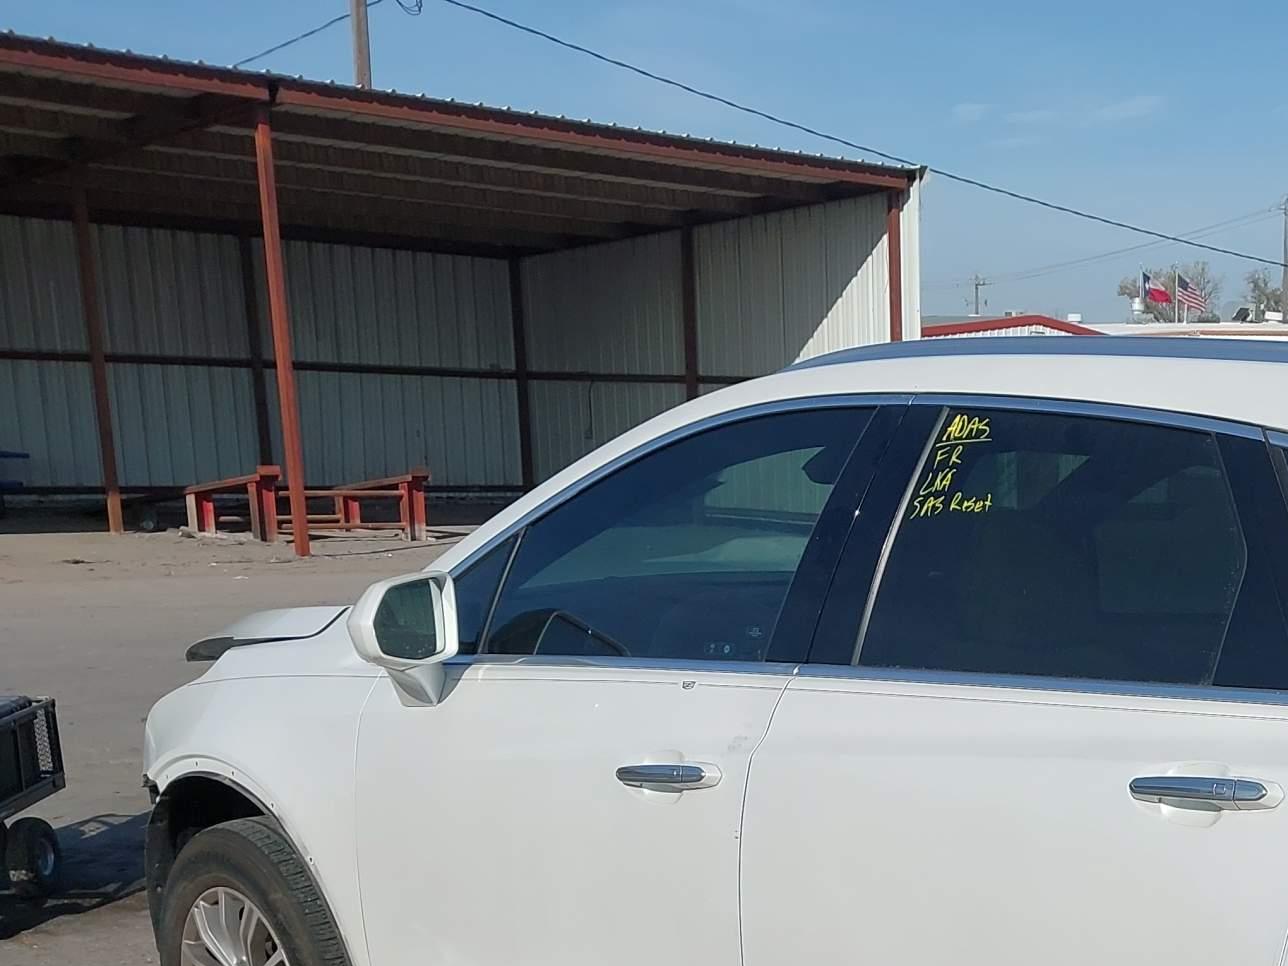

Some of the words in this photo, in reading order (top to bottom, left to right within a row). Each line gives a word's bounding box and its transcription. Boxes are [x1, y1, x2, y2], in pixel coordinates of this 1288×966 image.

[942, 414, 991, 441] ADAS
[934, 445, 963, 469] FR
[919, 468, 957, 496] LKA
[910, 495, 945, 520] SAS
[949, 492, 992, 512] Reset
